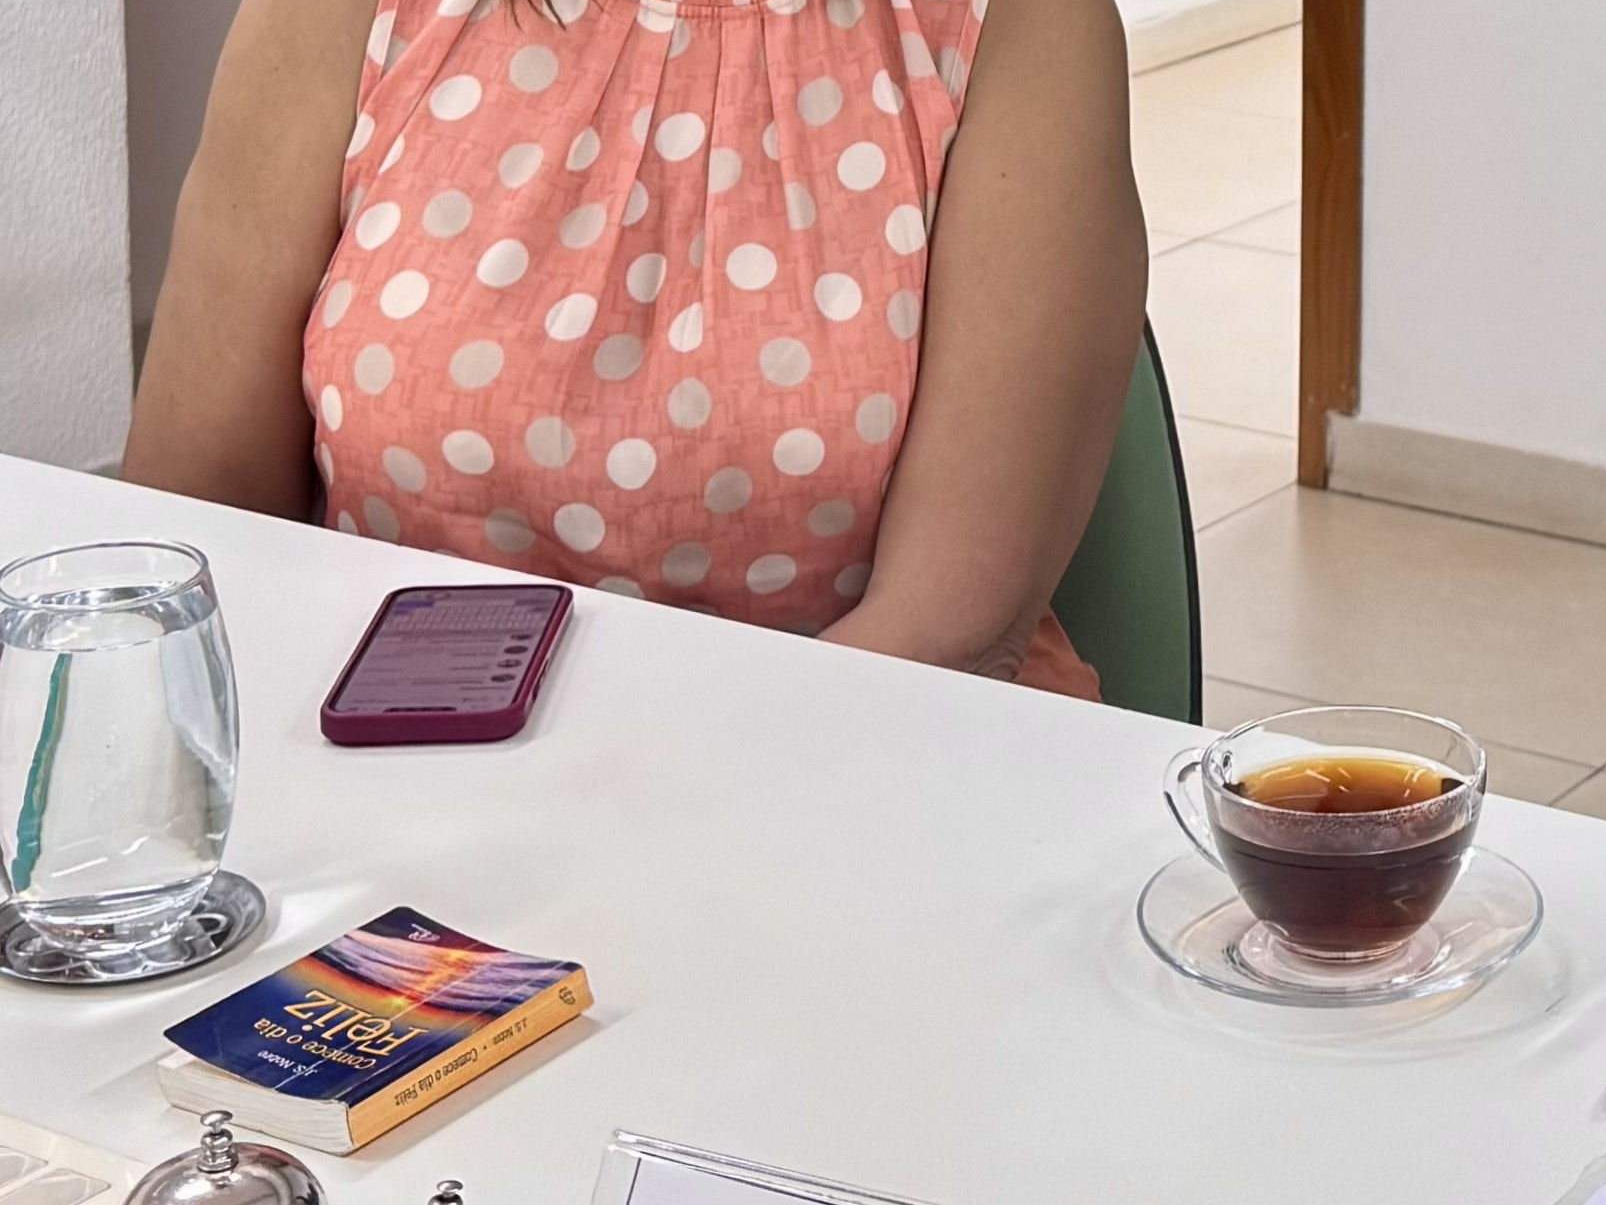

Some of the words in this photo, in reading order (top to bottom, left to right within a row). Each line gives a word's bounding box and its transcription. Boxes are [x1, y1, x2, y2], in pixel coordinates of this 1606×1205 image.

[253, 1018, 287, 1039] dia
[286, 1034, 303, 1044] o
[302, 1041, 377, 1070] Comece
[442, 1048, 478, 1076] Comece
[418, 1074, 434, 1092] dia
[434, 1069, 441, 1081] o
